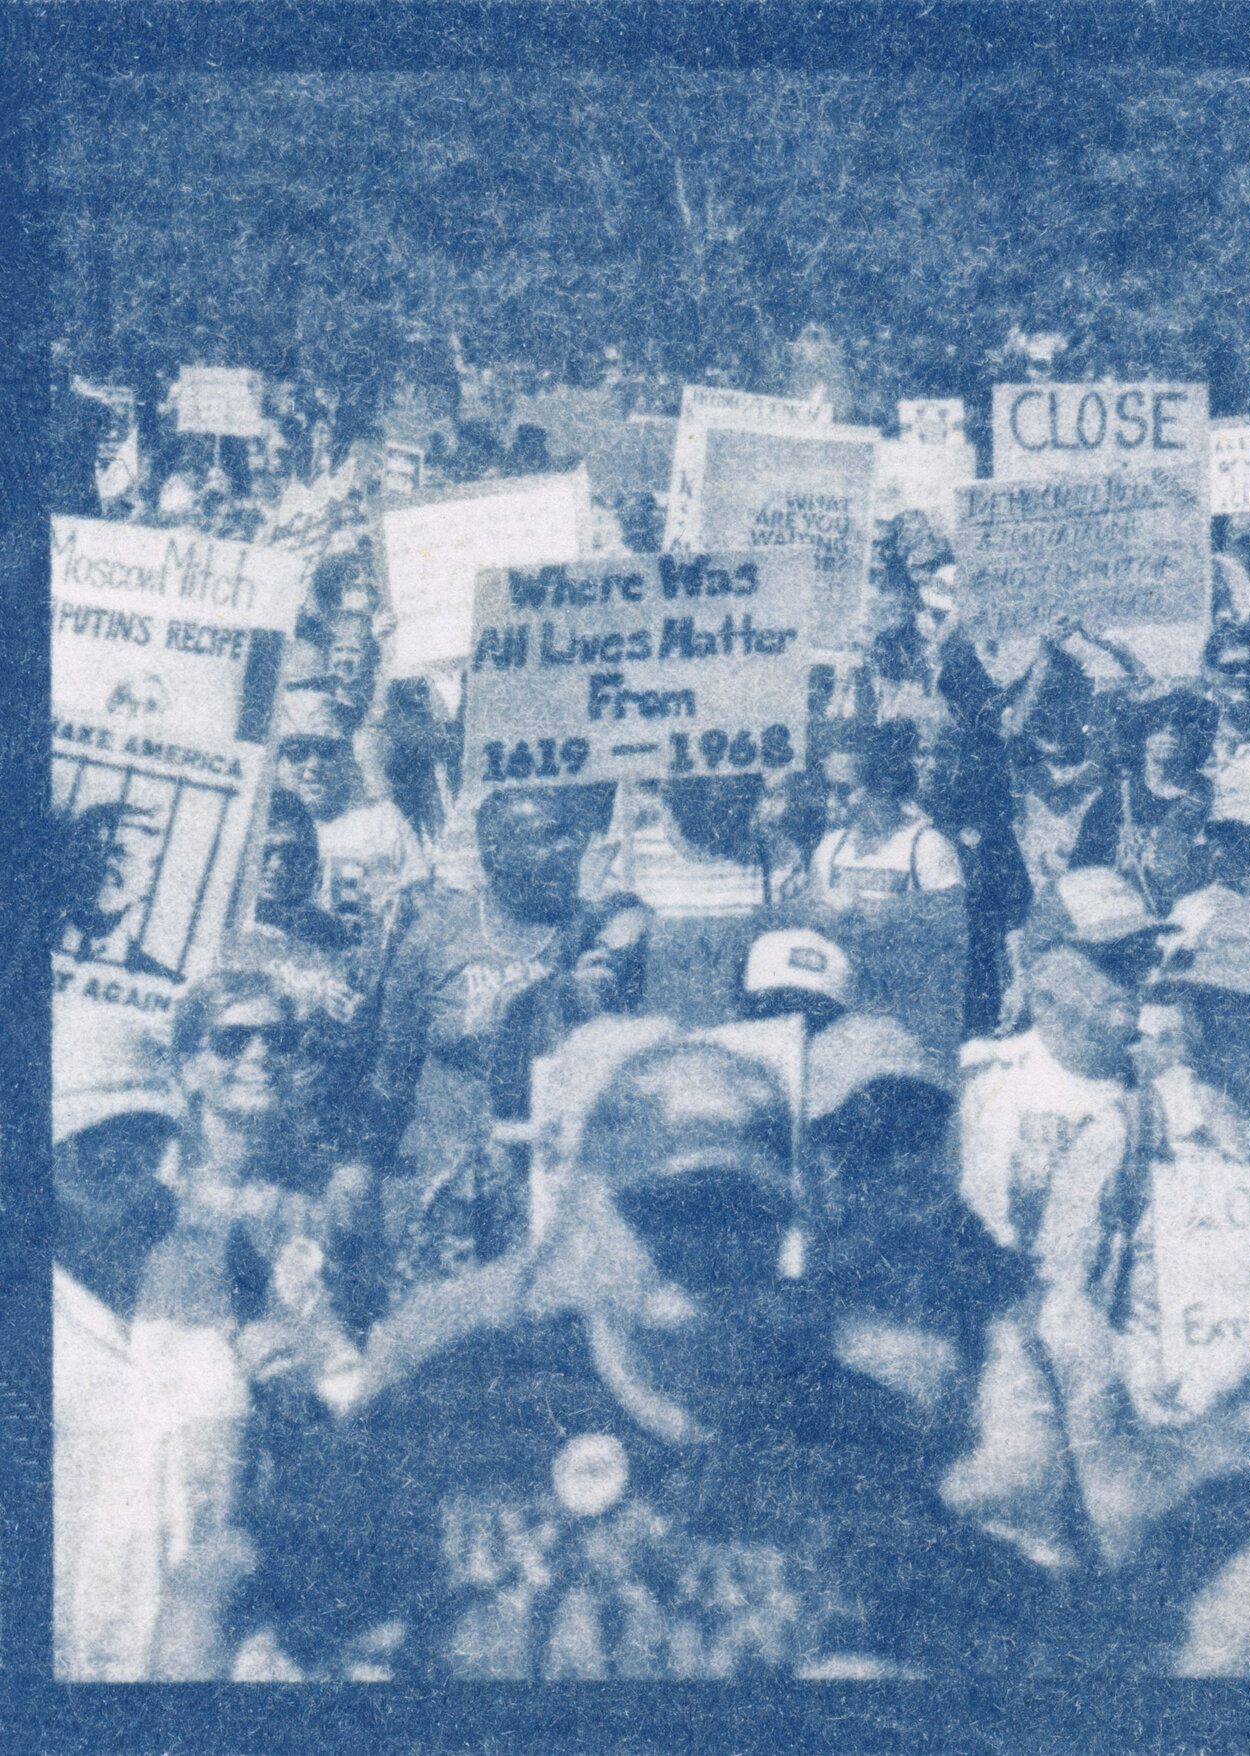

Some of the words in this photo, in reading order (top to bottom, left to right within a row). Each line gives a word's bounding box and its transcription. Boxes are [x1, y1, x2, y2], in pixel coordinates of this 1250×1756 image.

[1010, 390, 1189, 451] CLOSE
[755, 507, 797, 528] ARE
[802, 513, 850, 536] YOU
[158, 536, 256, 610] Mitch
[507, 564, 645, 609] Where
[658, 553, 759, 600] Was
[165, 619, 248, 661] RECIPE
[472, 621, 529, 673] All
[540, 620, 651, 666] Lives
[657, 612, 798, 661] Matter
[588, 672, 697, 720] From
[122, 735, 243, 780] AMERICA
[482, 735, 590, 783] 1619
[669, 723, 794, 774] 1968
[83, 977, 172, 1014] AGAIN
